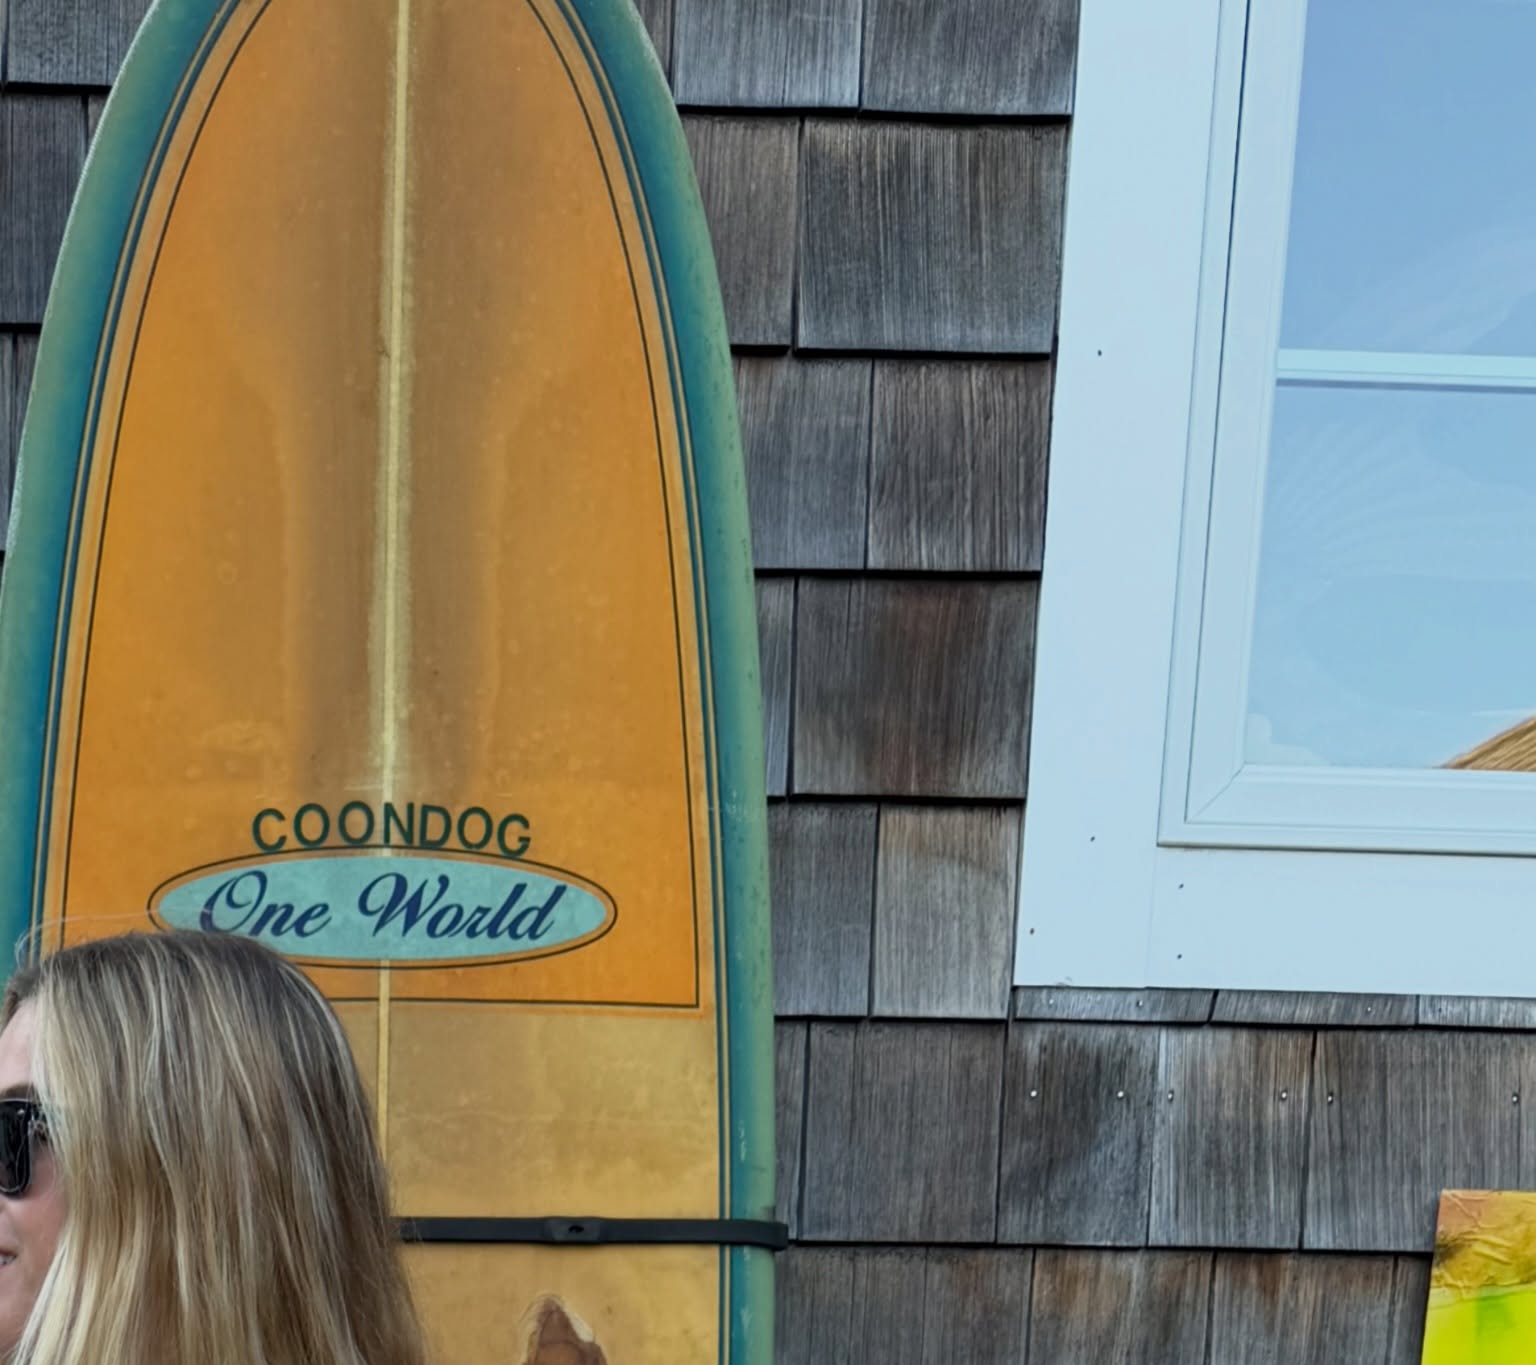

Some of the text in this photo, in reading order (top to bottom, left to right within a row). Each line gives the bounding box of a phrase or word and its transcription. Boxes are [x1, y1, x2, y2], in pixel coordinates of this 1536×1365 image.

[251, 800, 532, 858] COONDOG
[199, 870, 569, 942] One World
